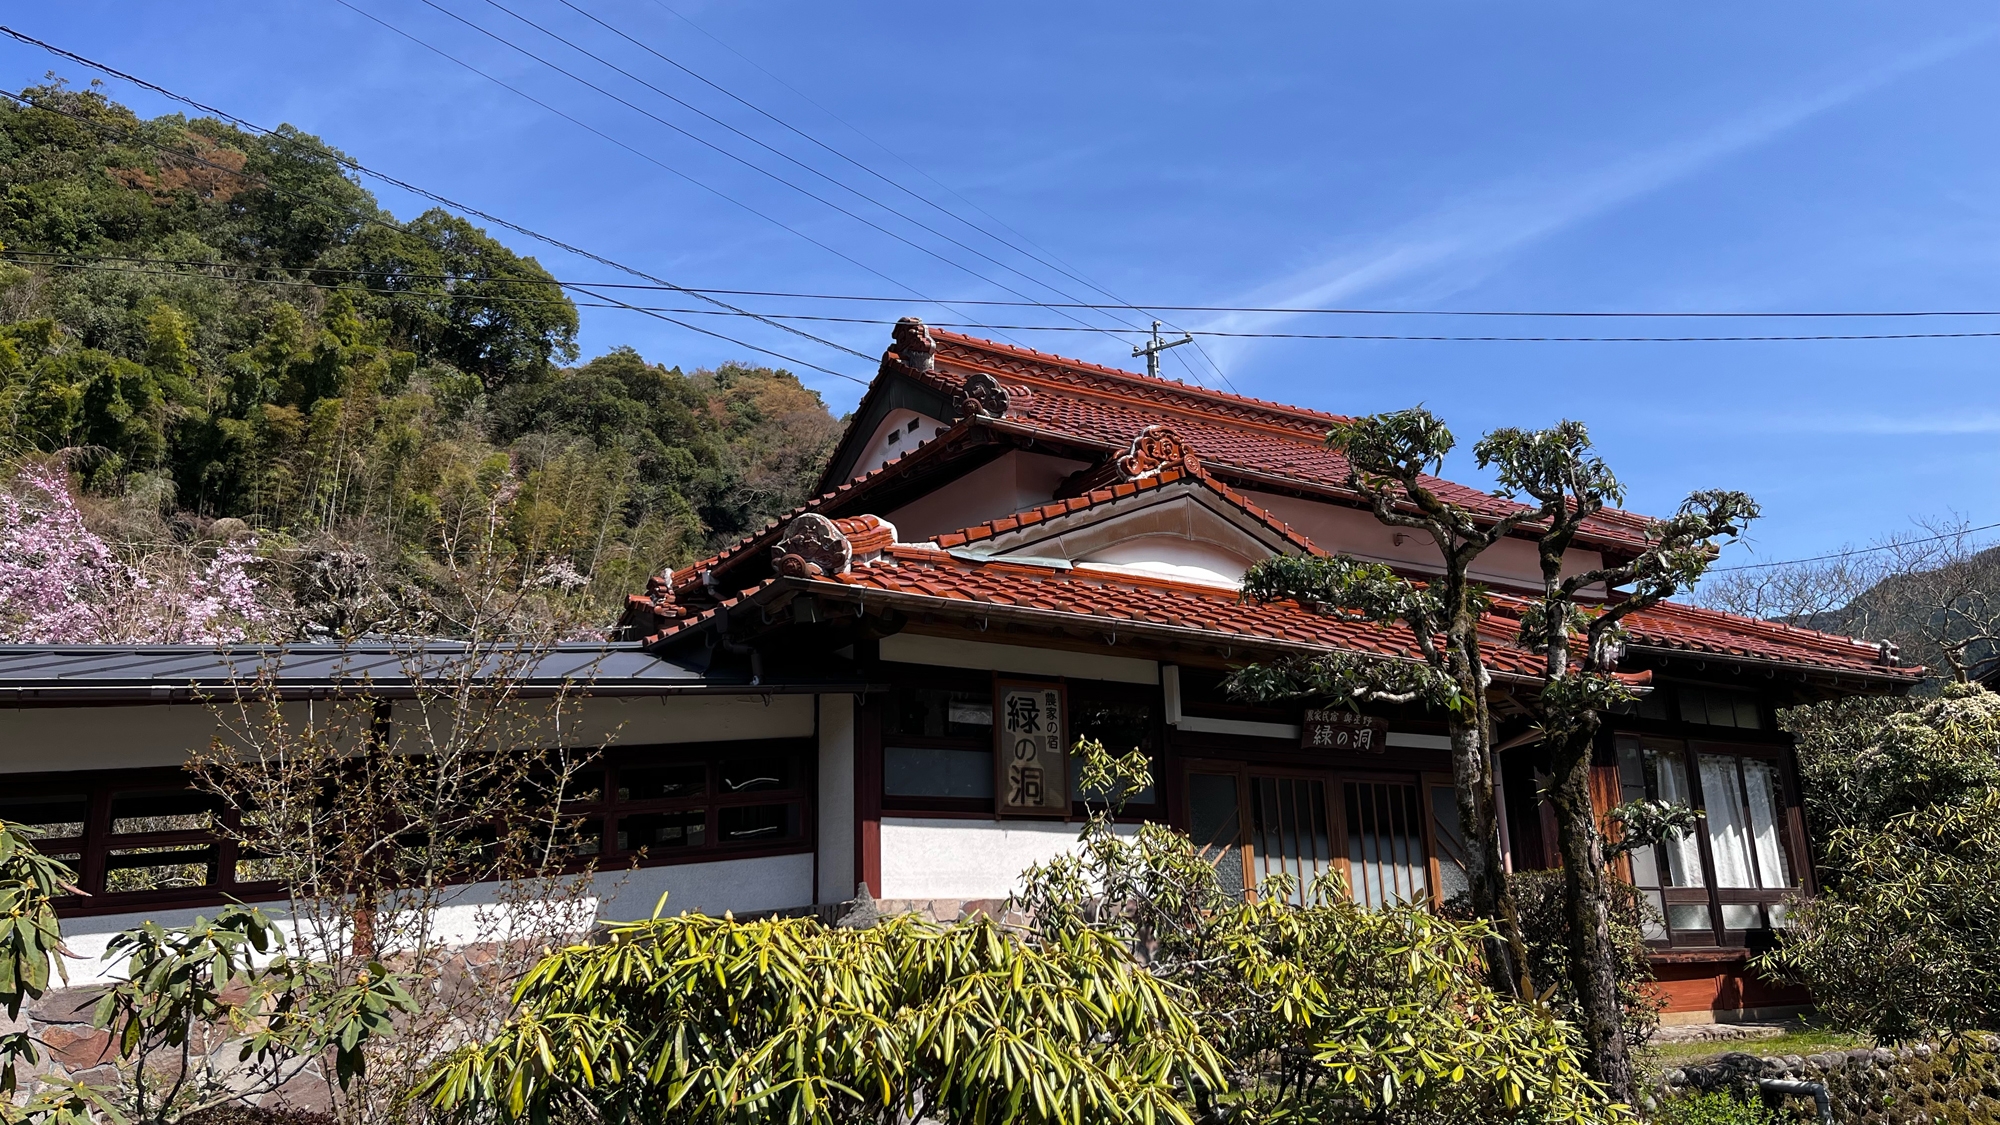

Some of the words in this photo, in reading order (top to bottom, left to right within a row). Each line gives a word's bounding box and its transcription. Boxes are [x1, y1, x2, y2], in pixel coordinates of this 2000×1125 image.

[1045, 692, 1059, 750] 農家の宿
[1313, 725, 1373, 750] 緑の洞
[1007, 695, 1044, 806] 緑の洞
